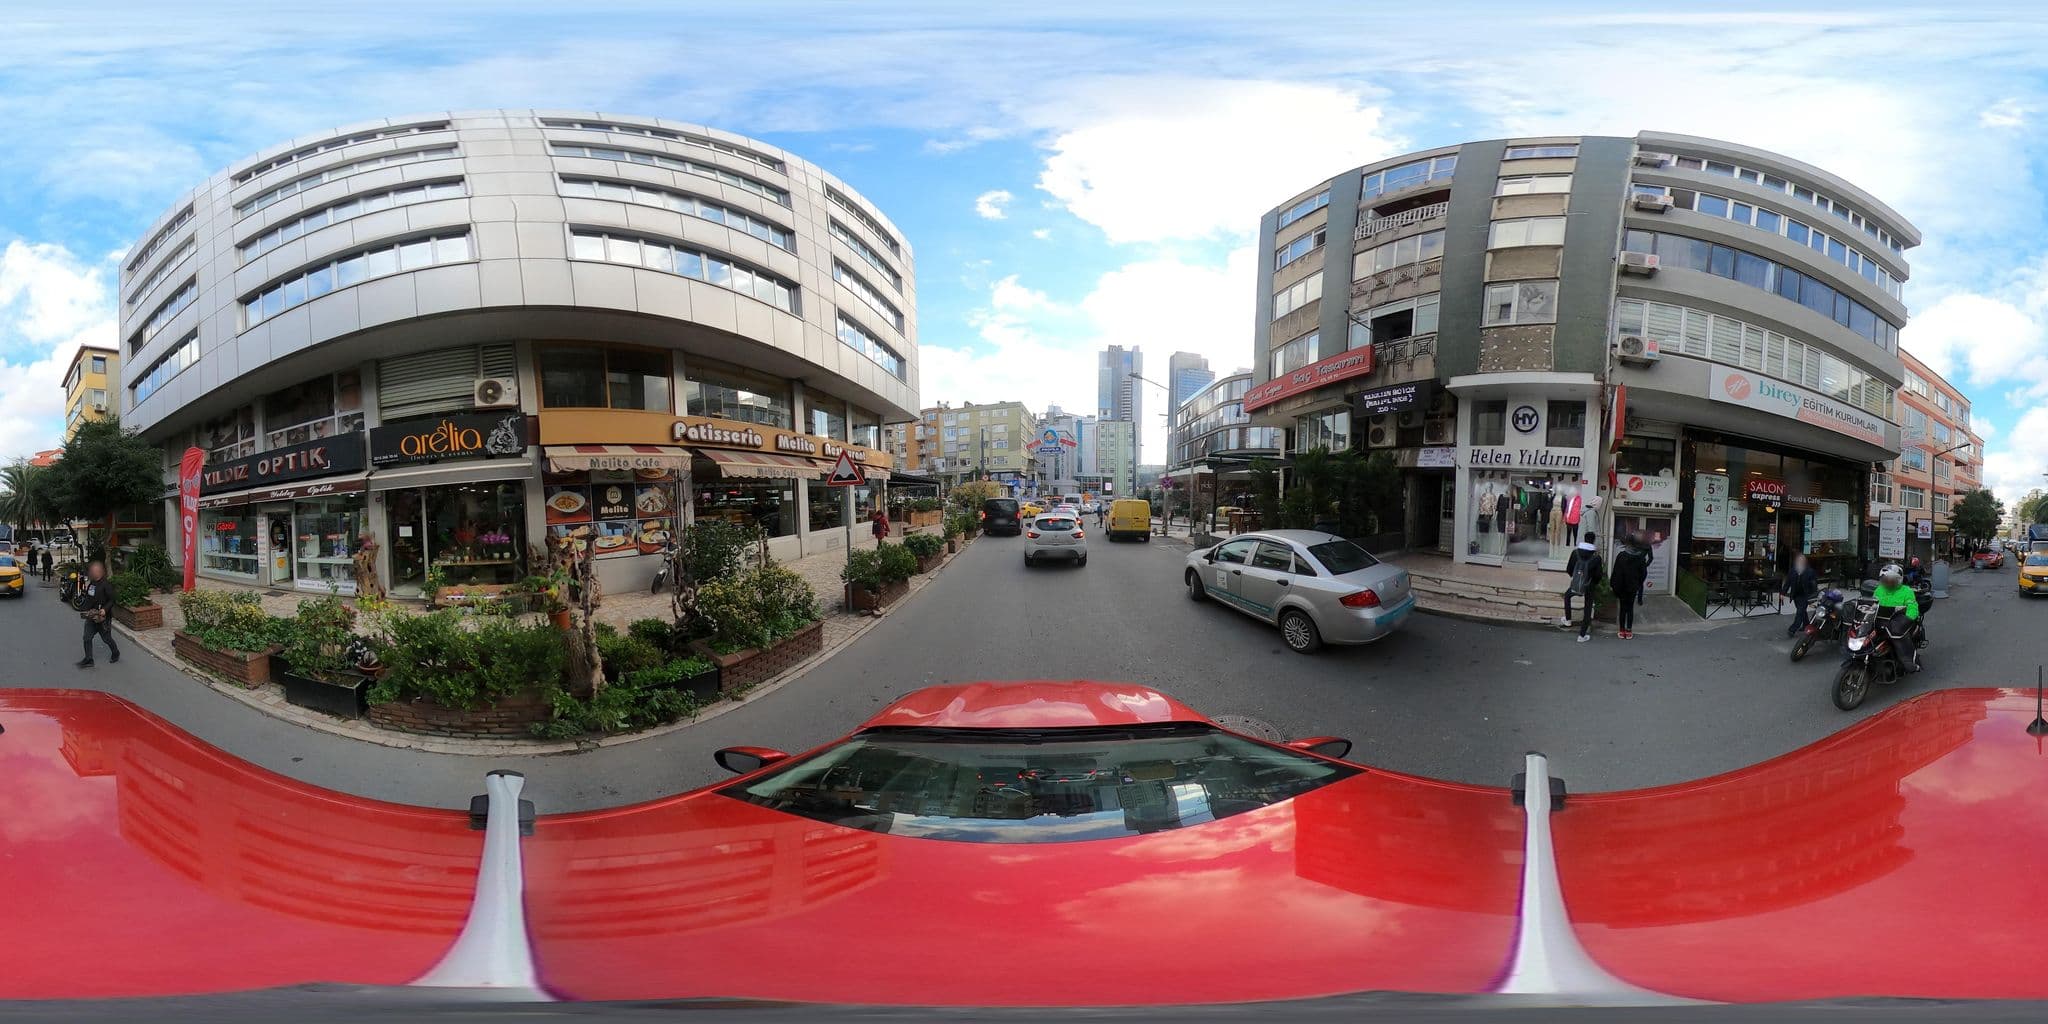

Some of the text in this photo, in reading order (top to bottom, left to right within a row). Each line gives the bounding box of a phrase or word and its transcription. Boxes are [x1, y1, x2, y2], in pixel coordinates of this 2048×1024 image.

[1759, 380, 1801, 407] birey
[1803, 398, 1833, 416] EĞİTİM
[1835, 408, 1878, 432] KURUMLARI
[400, 419, 482, 456] arelia
[1470, 448, 1581, 467] Helen Yıldırım
[204, 464, 249, 487] YILDIZ
[1750, 480, 1784, 494] SALON
[1751, 493, 1781, 501] express
[1787, 494, 1803, 503] Food
